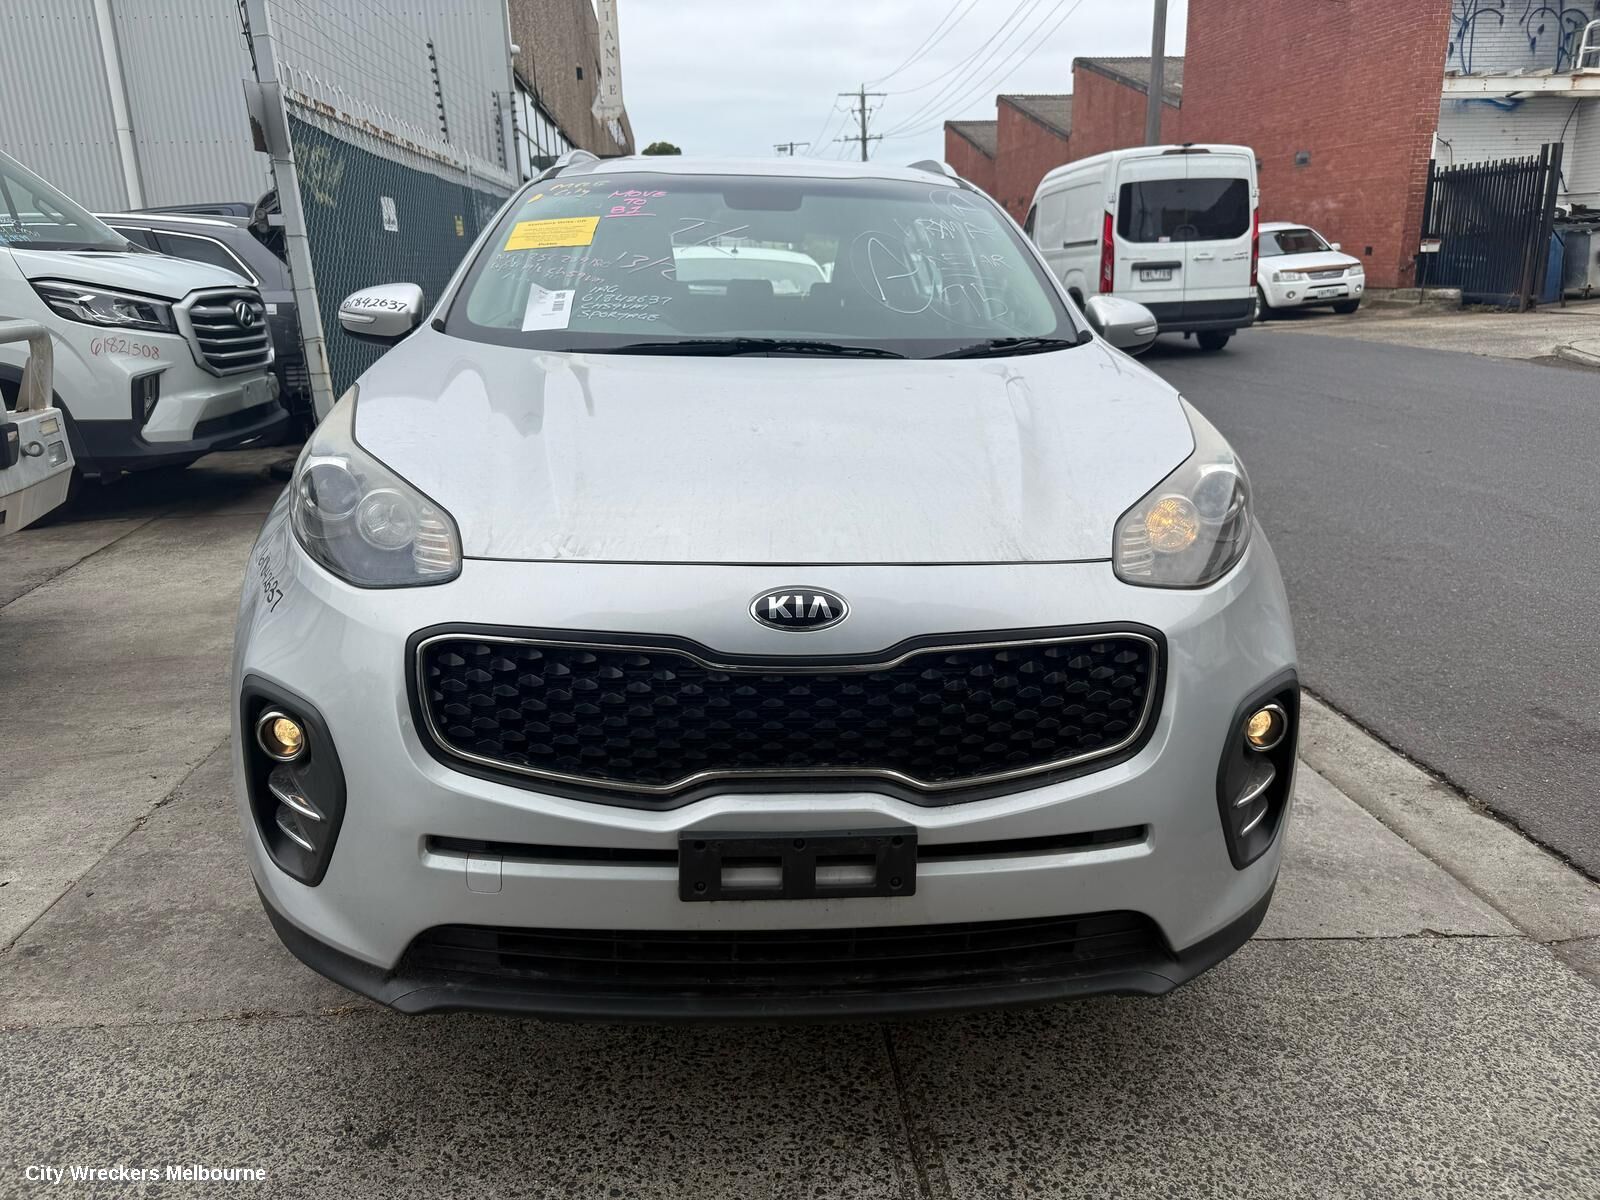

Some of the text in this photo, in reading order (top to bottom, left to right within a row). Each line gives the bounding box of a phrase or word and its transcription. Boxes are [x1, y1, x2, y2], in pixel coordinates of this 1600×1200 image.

[602, 0, 617, 95] IANNE
[90, 336, 160, 360] 61821508
[767, 595, 833, 619] KIA
